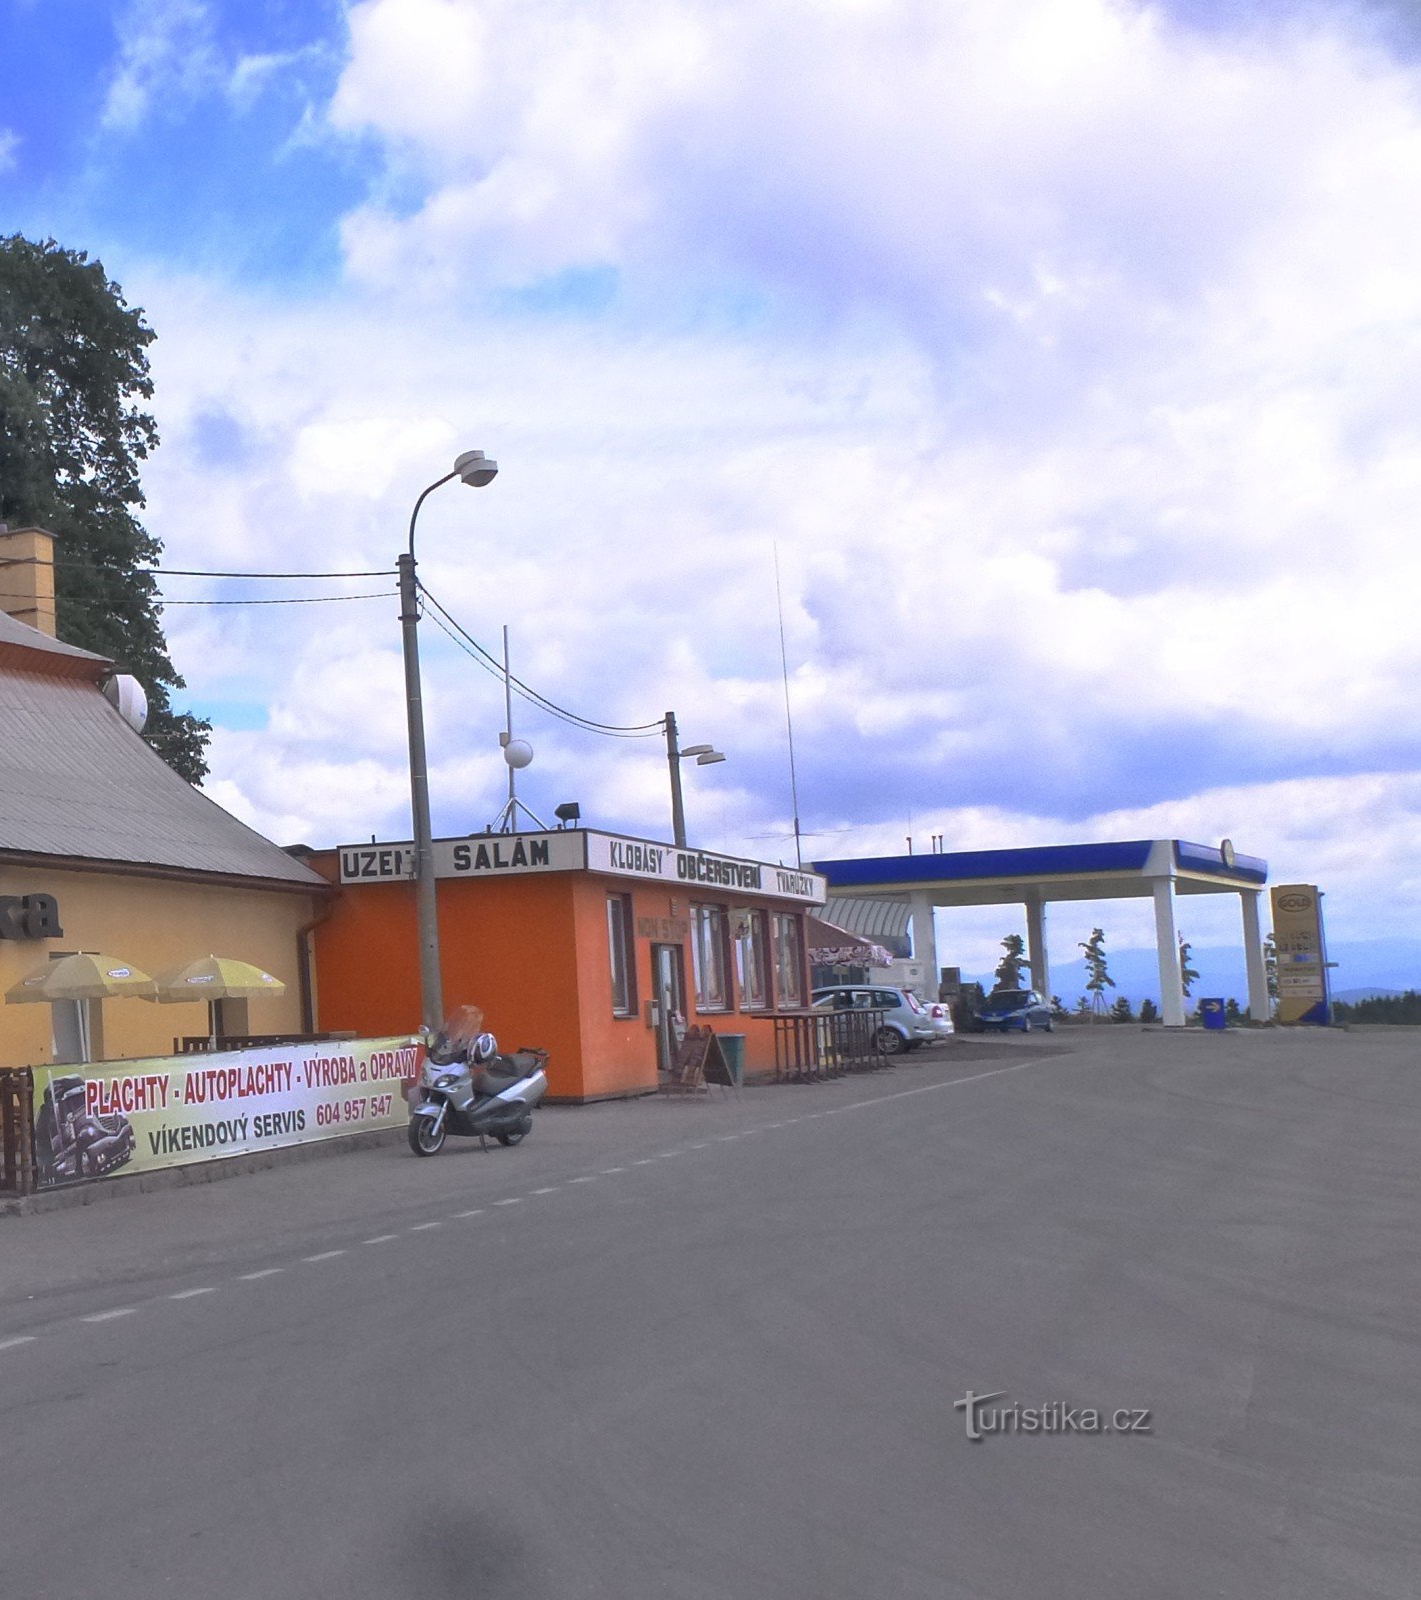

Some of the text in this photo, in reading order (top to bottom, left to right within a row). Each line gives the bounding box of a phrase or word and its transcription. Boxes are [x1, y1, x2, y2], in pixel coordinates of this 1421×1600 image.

[453, 837, 549, 870] SALÁM
[610, 841, 662, 874] KLOBÁSY
[85, 1074, 169, 1117] PLACHTY
[184, 1061, 292, 1105] AUTOPLACHTY
[303, 1051, 356, 1089] VÝROBA
[359, 1065, 366, 1081] a
[370, 1048, 417, 1080] OPRAVY
[148, 1095, 393, 1155] VÍKENDOVÝ SERVIS 604 957 547
